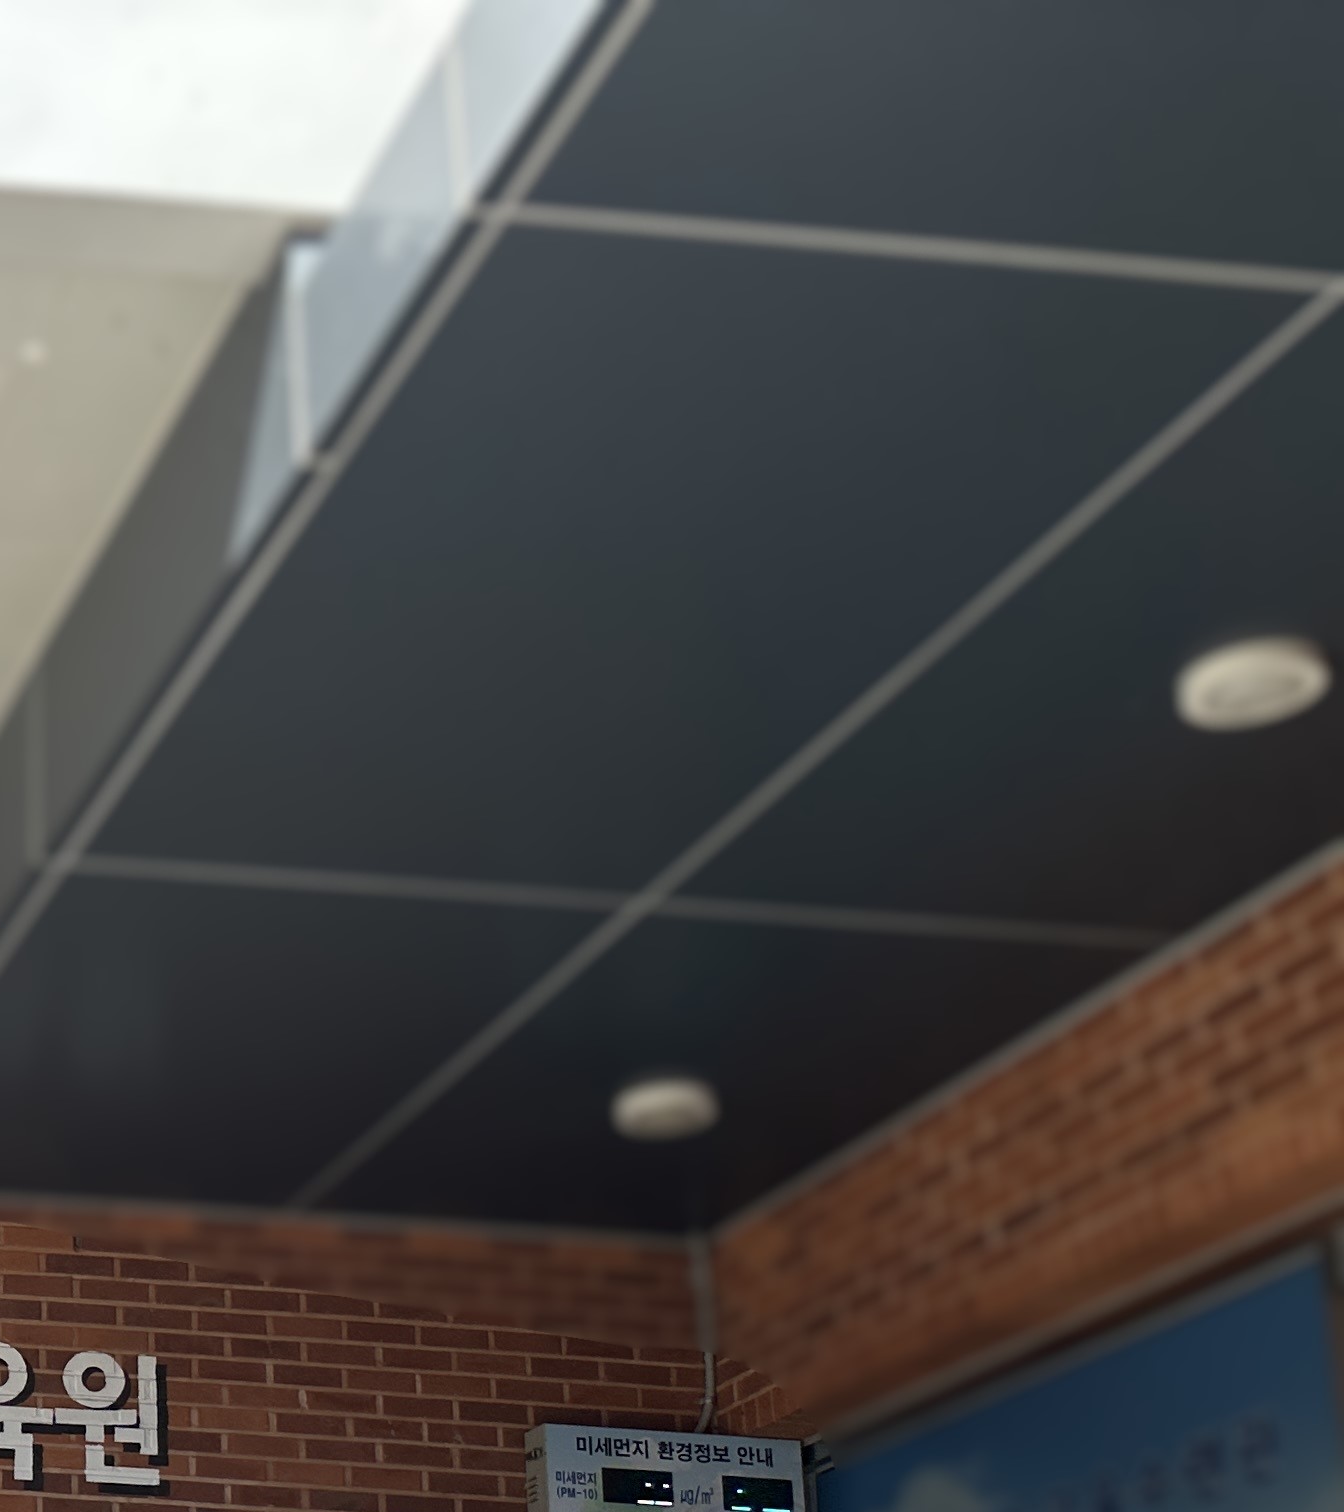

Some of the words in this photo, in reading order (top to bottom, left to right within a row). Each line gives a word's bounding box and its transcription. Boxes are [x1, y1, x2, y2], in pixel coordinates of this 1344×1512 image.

[576, 1436, 649, 1459] 미세먼지
[657, 1441, 730, 1464] 환경정보
[737, 1447, 774, 1467] 안내
[555, 1470, 597, 1485] 미세먼지
